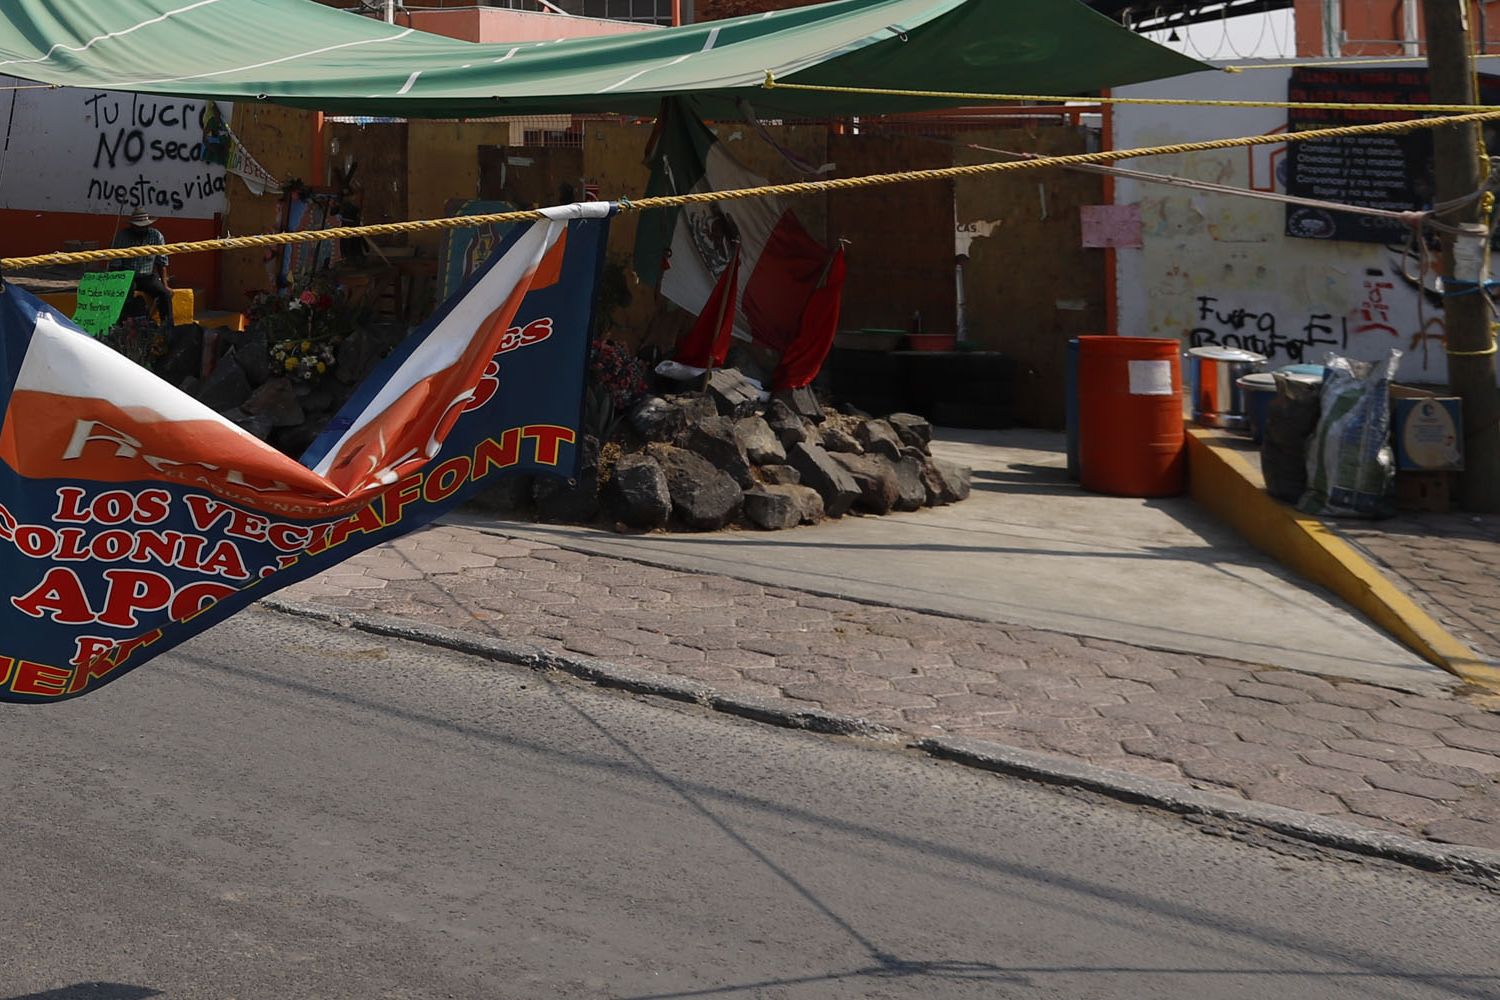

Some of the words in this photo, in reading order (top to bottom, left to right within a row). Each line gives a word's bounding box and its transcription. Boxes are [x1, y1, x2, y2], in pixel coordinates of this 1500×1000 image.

[84, 93, 119, 128] Tu
[92, 129, 145, 169] NO
[87, 174, 186, 212] nuestras
[52, 486, 172, 526] LOS
